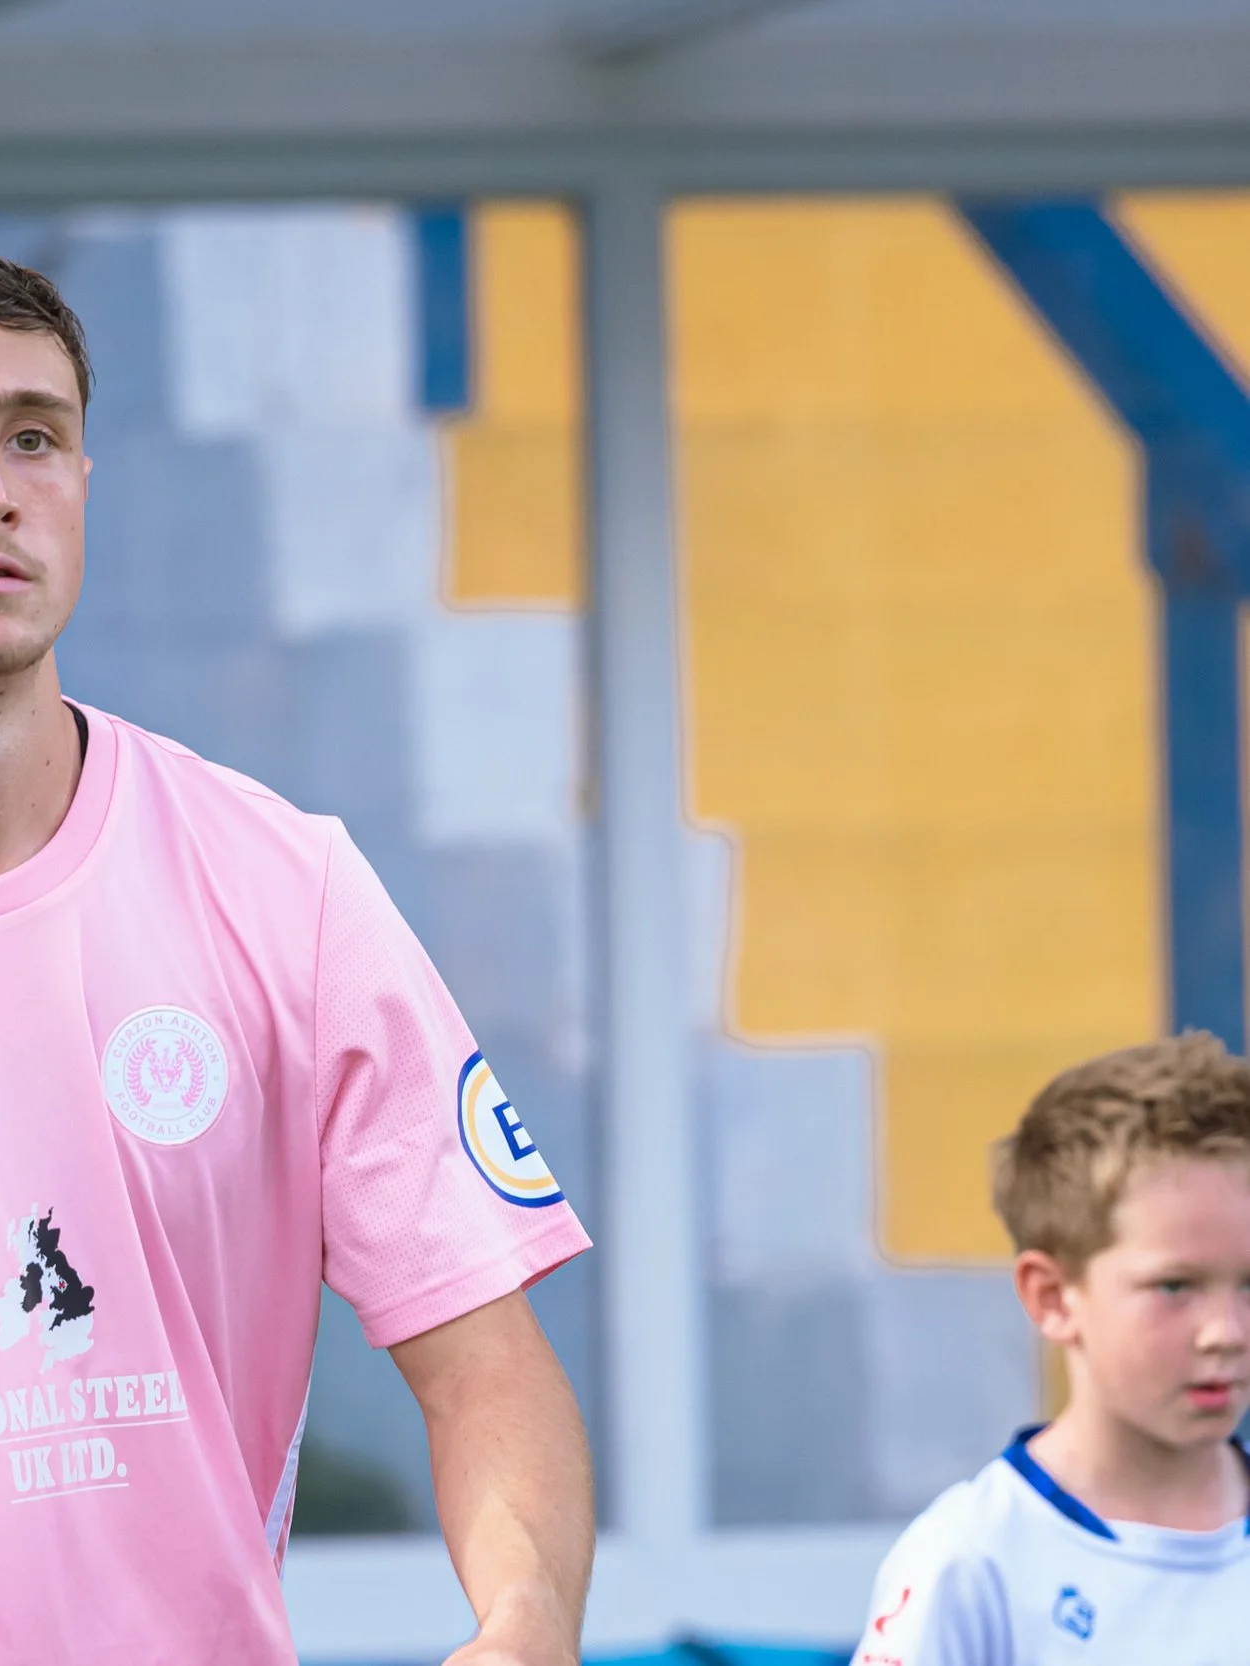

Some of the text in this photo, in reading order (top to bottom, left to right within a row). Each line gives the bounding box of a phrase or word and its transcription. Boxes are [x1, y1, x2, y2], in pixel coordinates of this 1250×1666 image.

[112, 1015, 220, 1064] CURZON ASHTON
[115, 1092, 217, 1136] FOOTBALL CLUB
[69, 1370, 188, 1422] STEEL
[9, 1437, 128, 1492] UK LTD.
